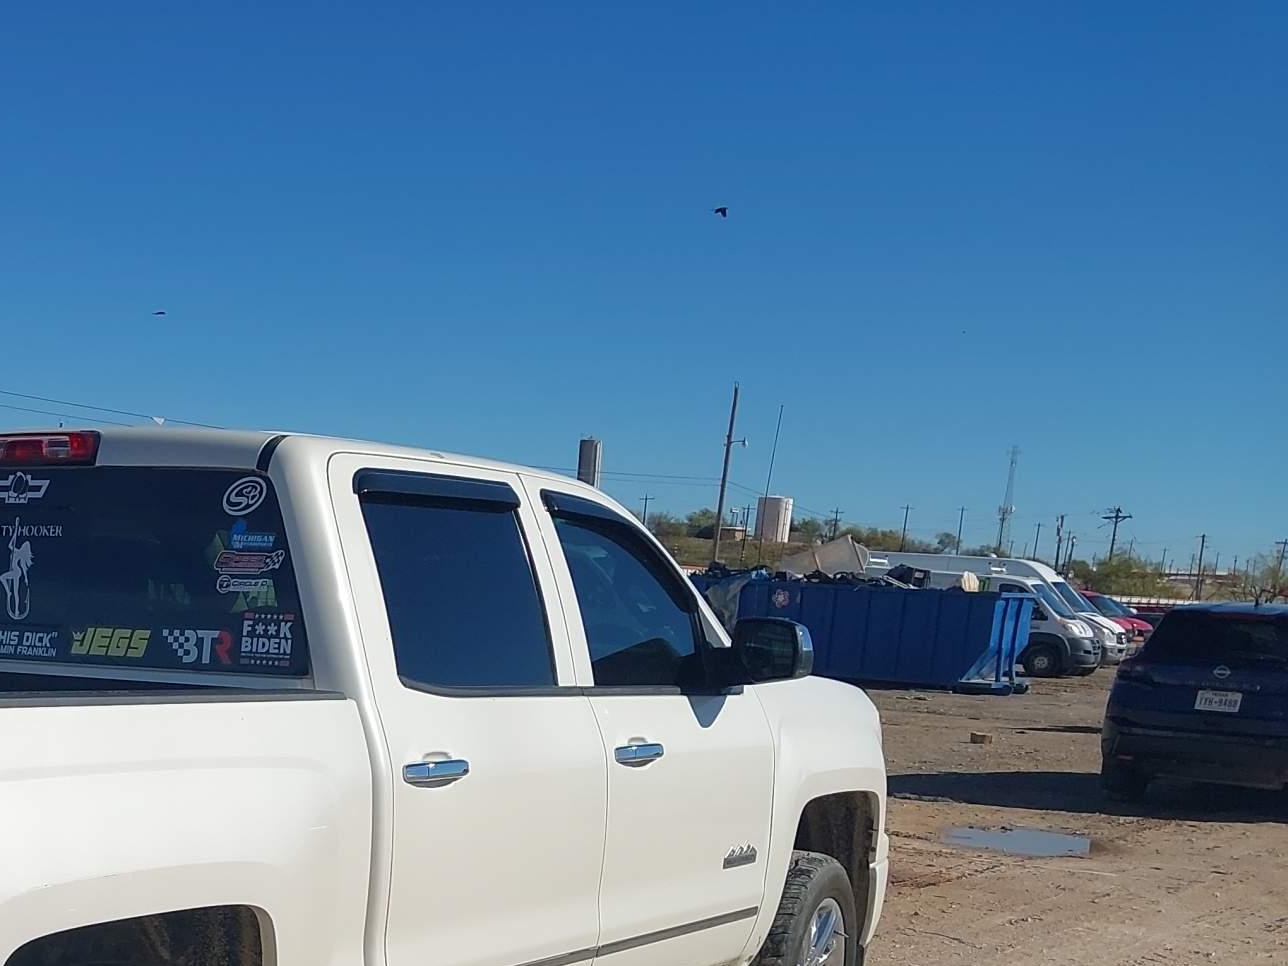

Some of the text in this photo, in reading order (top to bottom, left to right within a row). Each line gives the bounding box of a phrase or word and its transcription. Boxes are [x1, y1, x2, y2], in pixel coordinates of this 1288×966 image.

[17, 525, 63, 537] HOOKER
[70, 627, 152, 657] JEGS
[182, 629, 233, 664] BTR
[241, 637, 292, 654] BIDEN
[16, 645, 57, 657] FRANKLIN
